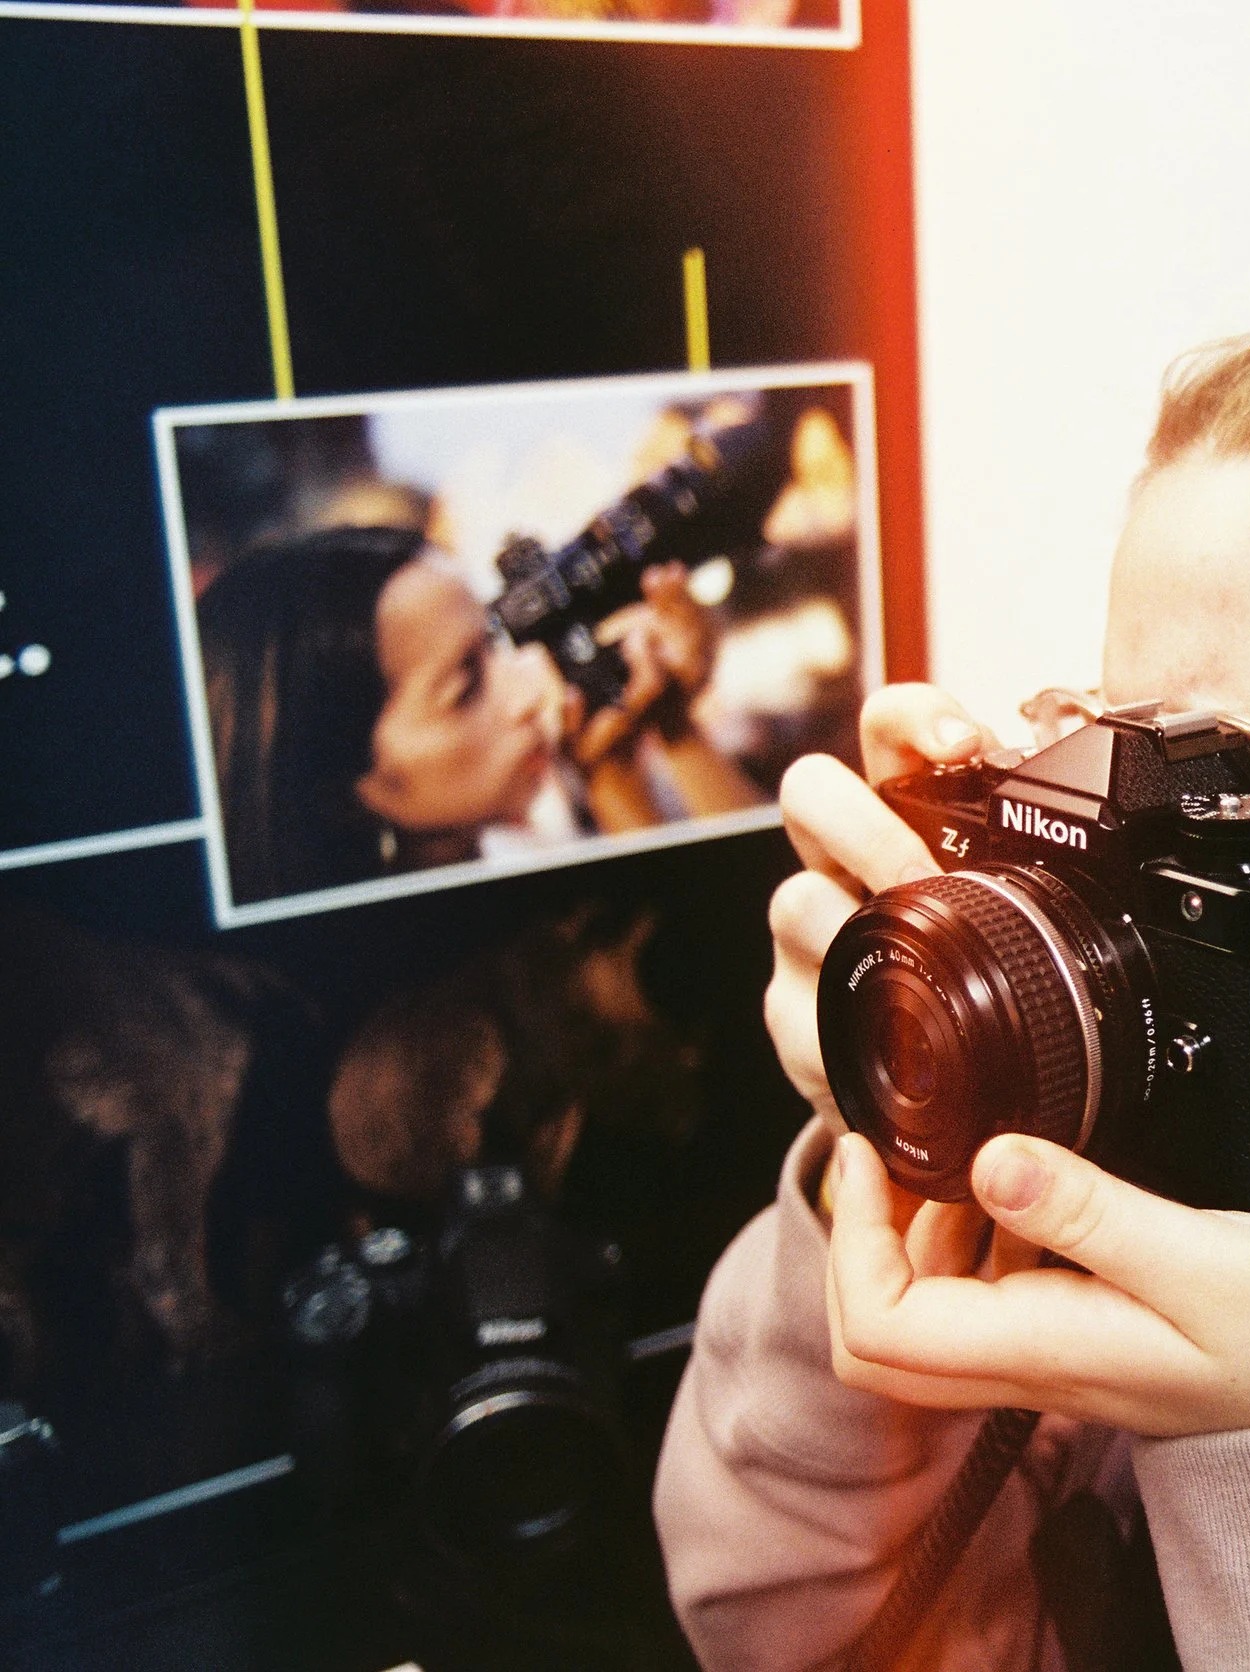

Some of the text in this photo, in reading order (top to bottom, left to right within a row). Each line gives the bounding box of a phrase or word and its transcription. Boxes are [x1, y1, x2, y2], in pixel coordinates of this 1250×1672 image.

[941, 826, 970, 858] Zf
[1002, 799, 1087, 850] Nikon
[848, 949, 915, 991] NIKKOR Z 40mm
[895, 1135, 929, 1161] Nikon
